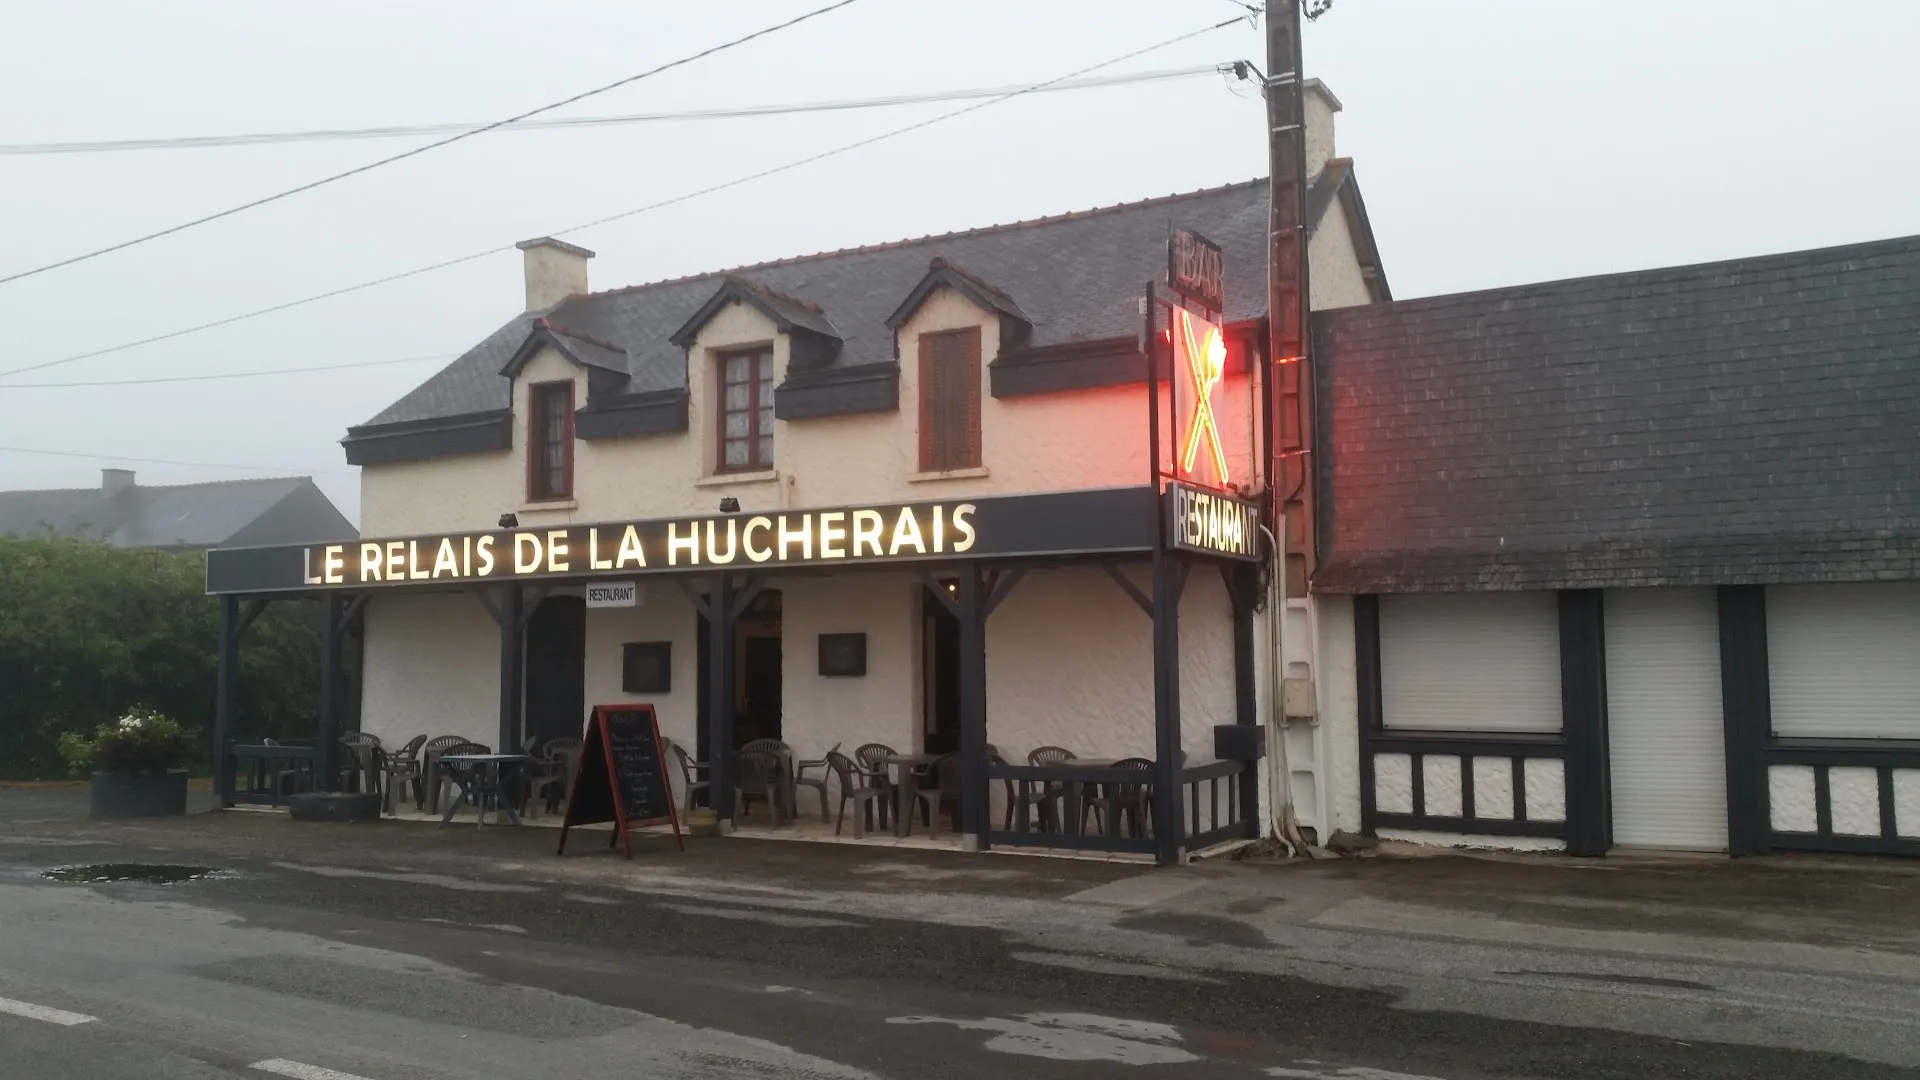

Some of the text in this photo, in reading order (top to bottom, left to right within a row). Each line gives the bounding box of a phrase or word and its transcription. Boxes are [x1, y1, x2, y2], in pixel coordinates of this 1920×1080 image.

[1177, 229, 1225, 300] BAR
[304, 503, 977, 585] LE RELAIS DE LA HUCHERAIS
[1178, 487, 1258, 556] RESTAURANT
[589, 587, 634, 602] RESTAURANT
